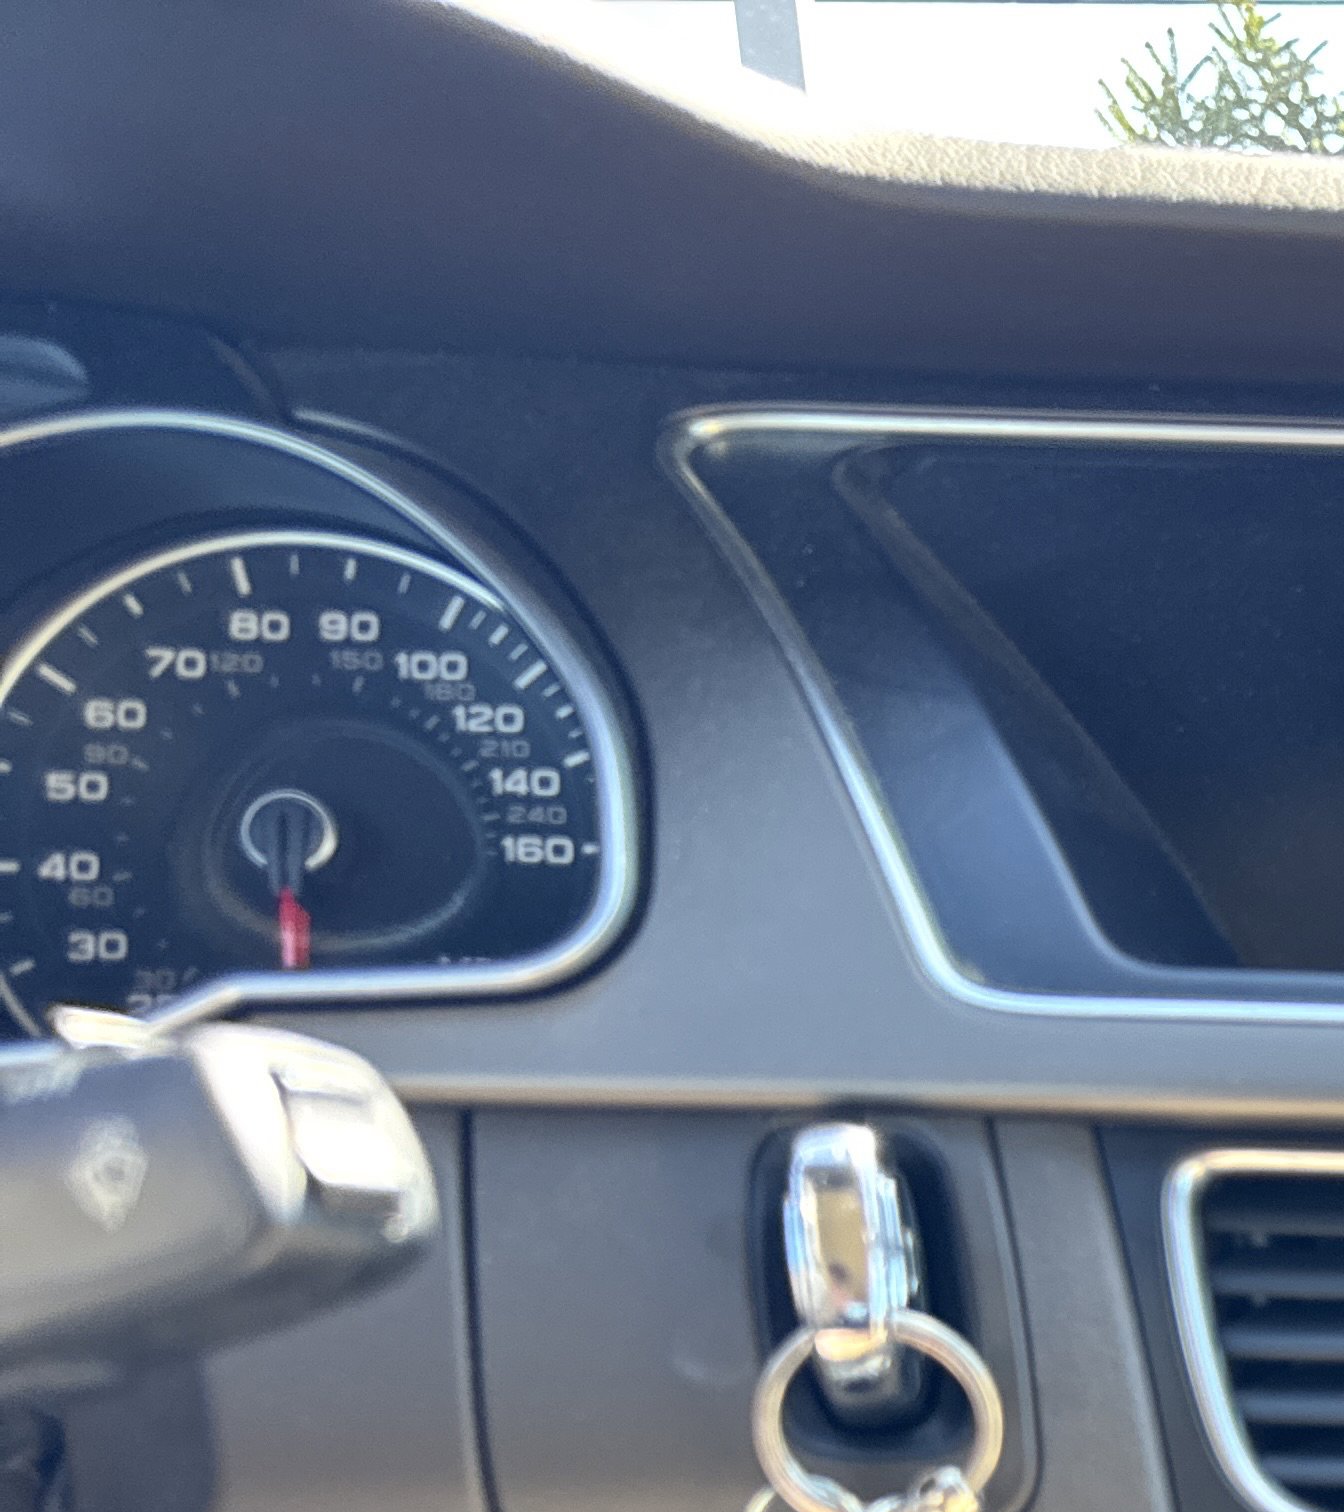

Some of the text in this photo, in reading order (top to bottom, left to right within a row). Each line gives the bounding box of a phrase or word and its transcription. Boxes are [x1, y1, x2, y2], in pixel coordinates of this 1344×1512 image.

[228, 611, 290, 641] 80
[319, 611, 379, 641] 90
[145, 648, 206, 677] 70
[210, 651, 263, 674] 120
[329, 650, 384, 671] 150
[395, 652, 468, 681] 100
[84, 700, 147, 730] 60
[452, 704, 525, 733] 120
[478, 739, 531, 759] 210
[45, 772, 109, 801] 50
[489, 768, 561, 797] 140
[506, 804, 568, 825] 240
[501, 834, 575, 865] 160
[38, 853, 99, 882] 40
[67, 932, 128, 961] 30
